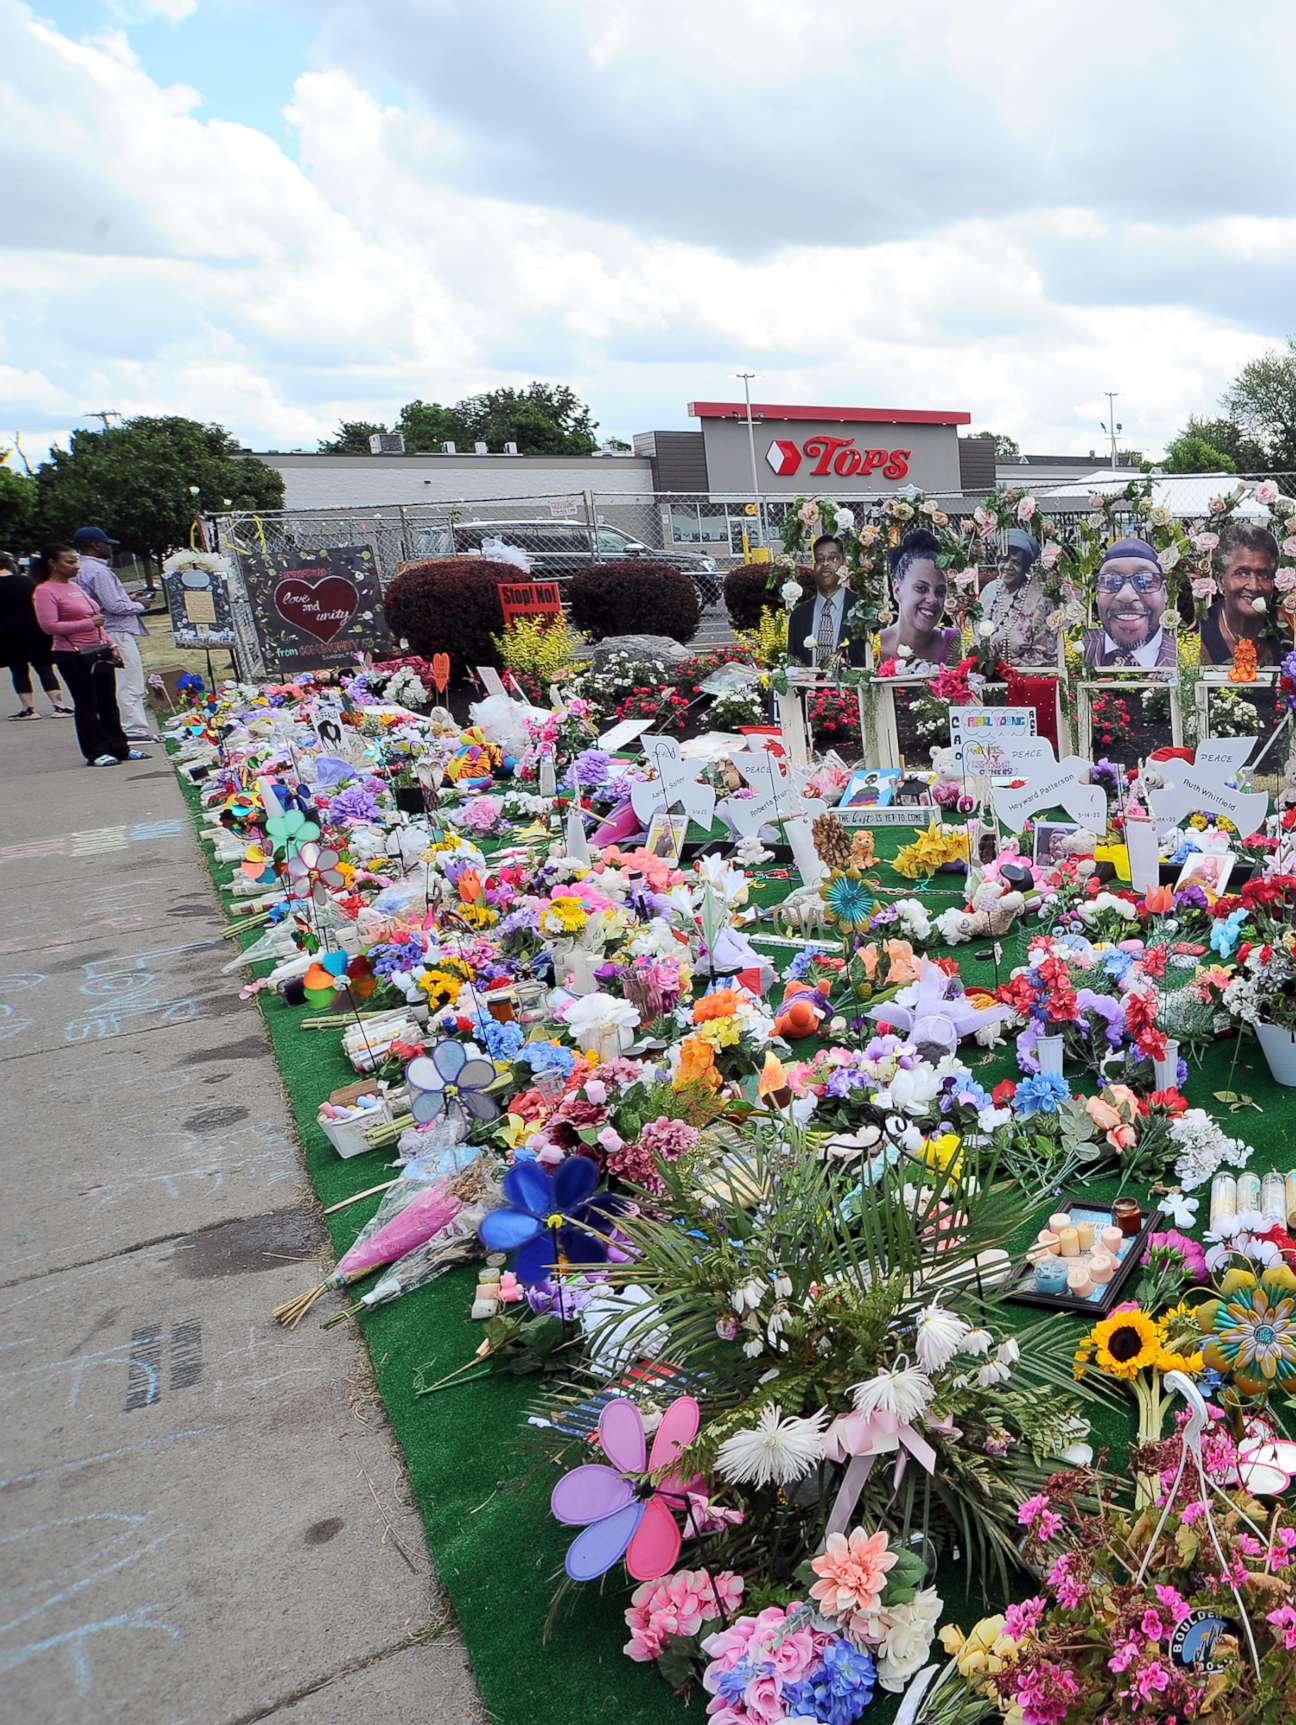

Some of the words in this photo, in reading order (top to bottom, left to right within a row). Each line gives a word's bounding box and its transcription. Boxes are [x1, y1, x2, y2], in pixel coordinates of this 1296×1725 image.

[803, 435, 912, 480] TOPS
[282, 591, 311, 605] love
[502, 585, 535, 605] Stop!
[536, 584, 557, 604] No!
[302, 600, 320, 612] and
[316, 608, 351, 626] unity
[276, 647, 299, 658] from
[1012, 749, 1044, 759] PEACE
[1200, 753, 1233, 763] PEACE
[1008, 788, 1040, 812] Heyward
[1183, 778, 1202, 793] Ruth
[1201, 788, 1237, 811] Whitfield
[1172, 1610, 1223, 1653] BOULDE
